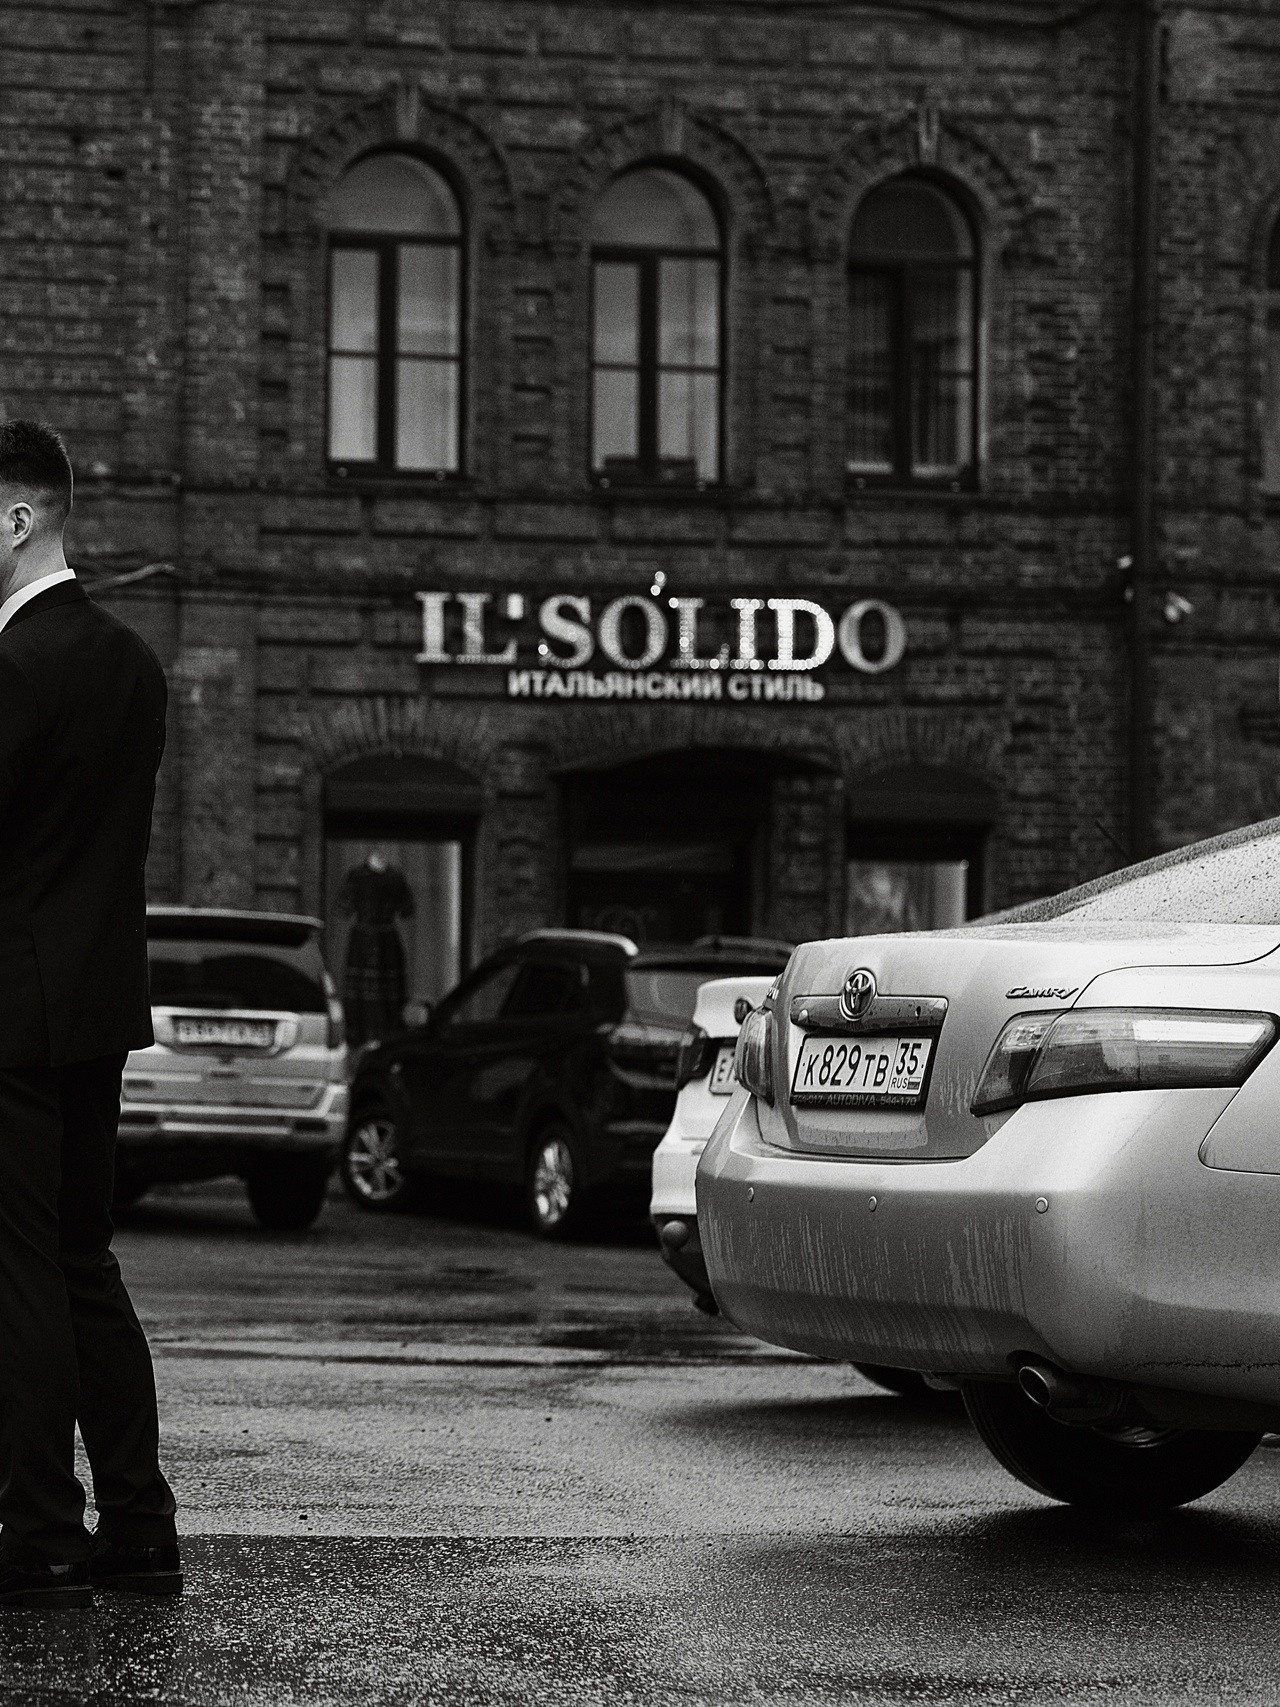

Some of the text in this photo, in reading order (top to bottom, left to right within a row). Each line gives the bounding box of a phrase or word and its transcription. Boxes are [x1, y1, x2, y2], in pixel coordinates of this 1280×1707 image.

[507, 670, 826, 701] ИТАЛЬЯНСКИЙ СТИЛЬ
[895, 1042, 923, 1076] 35
[890, 1077, 908, 1089] RUS
[825, 1094, 876, 1106] AUTODIVA
